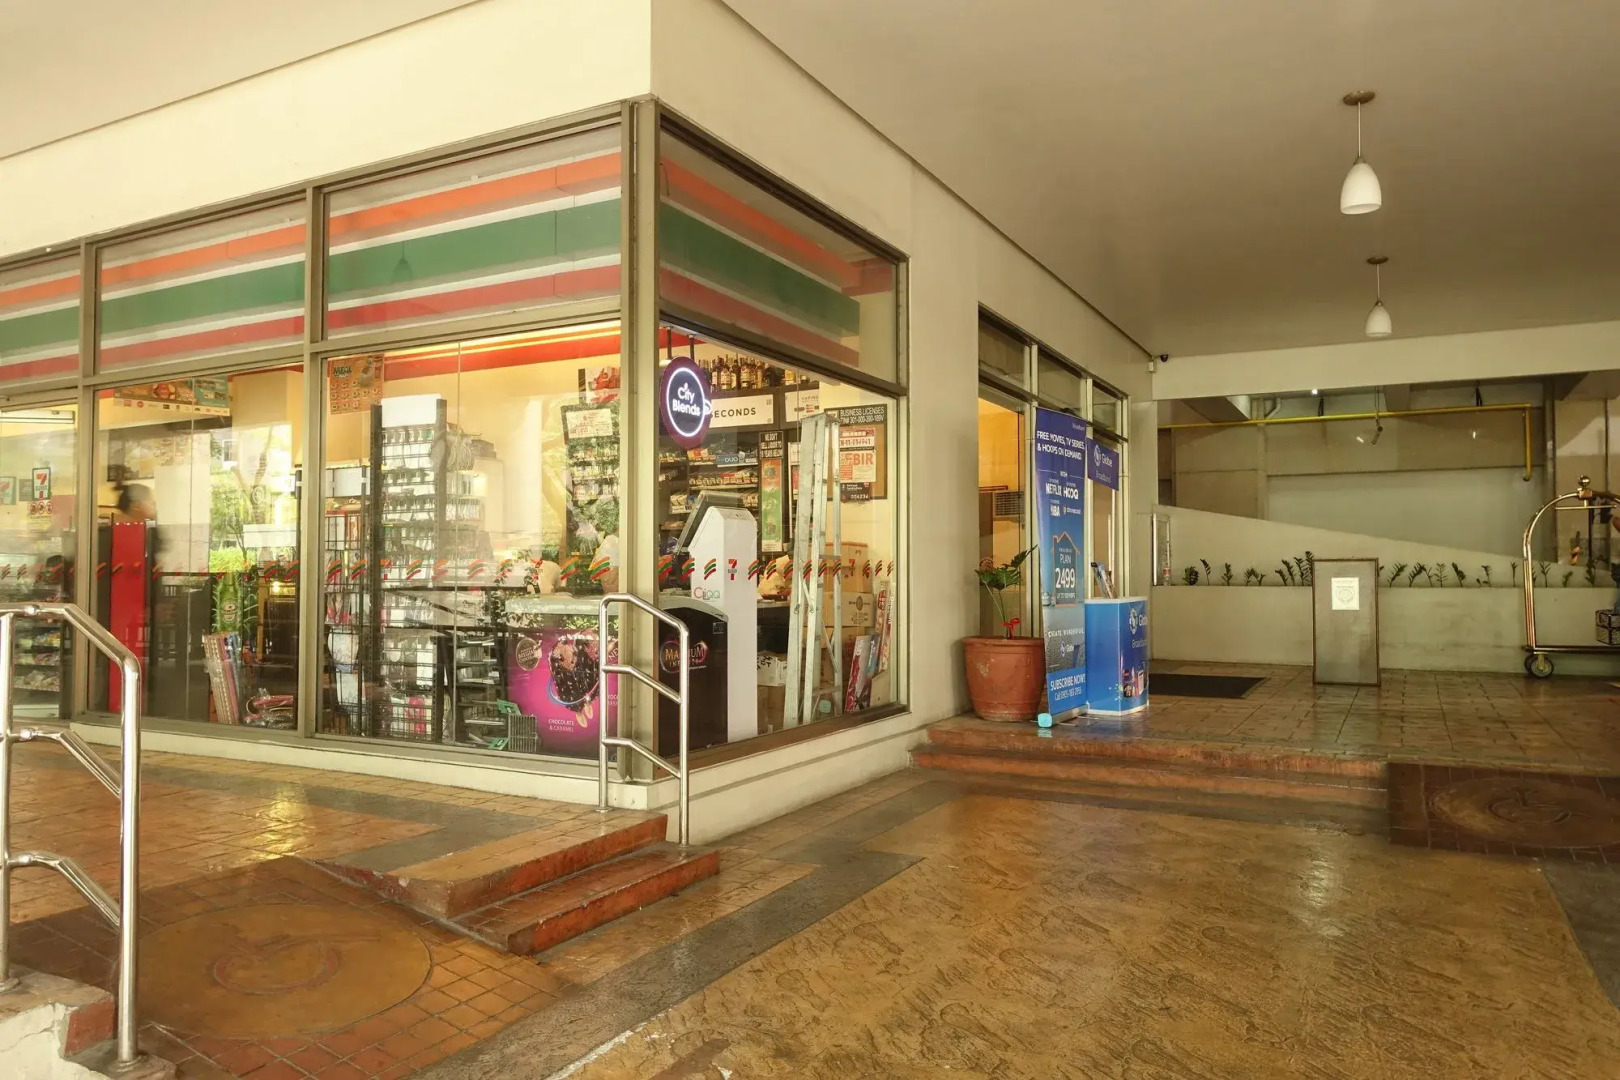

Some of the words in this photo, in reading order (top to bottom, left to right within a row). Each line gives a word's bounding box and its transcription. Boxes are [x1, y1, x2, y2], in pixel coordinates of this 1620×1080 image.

[677, 382, 695, 403] City
[672, 398, 701, 417] Blends
[840, 408, 862, 417] BUSINESS
[863, 406, 885, 415] LICENSES
[1037, 430, 1049, 440] FREE
[1037, 442, 1042, 451] &
[1042, 444, 1057, 454] HOOPS
[1058, 447, 1065, 456] ON
[853, 452, 873, 466] BIR
[1059, 553, 1072, 564] PLAN
[1055, 567, 1076, 589] 2499
[1050, 676, 1074, 691] SUBSCRIBE
[548, 718, 575, 726] CHOCOLATE
